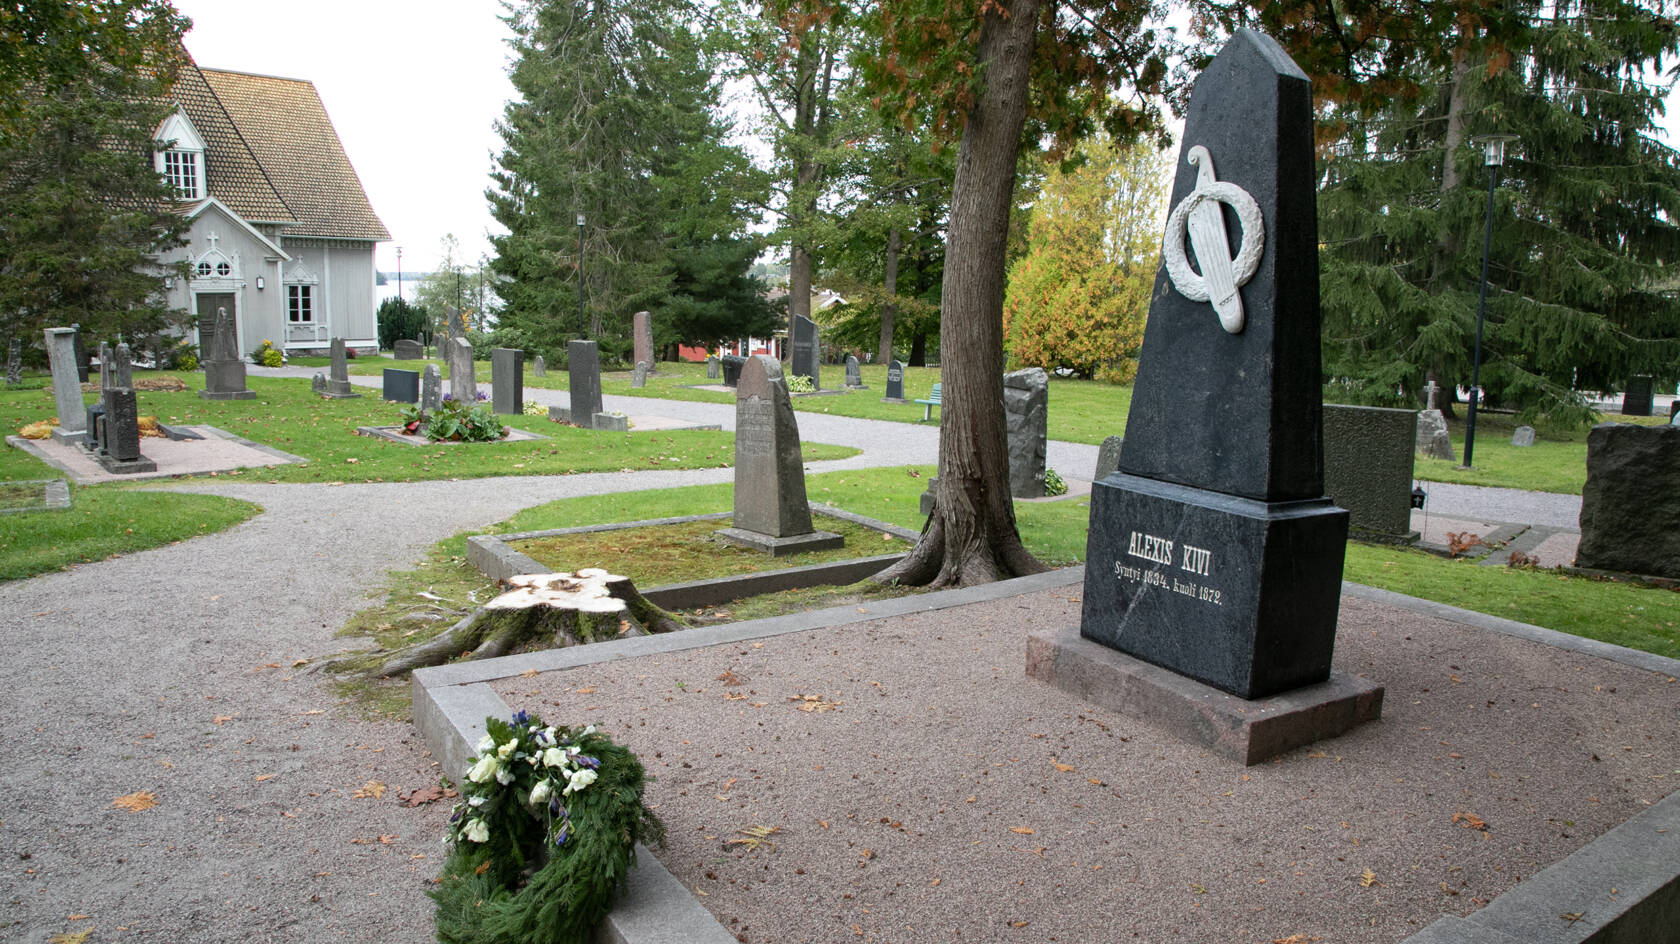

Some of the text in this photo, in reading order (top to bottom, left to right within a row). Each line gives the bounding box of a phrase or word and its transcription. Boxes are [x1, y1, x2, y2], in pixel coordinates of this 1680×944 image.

[1128, 531, 1211, 576] ALEXIS KIVI
[1115, 560, 1140, 583] Syntyi
[1173, 578, 1197, 597] kuoli
[1199, 587, 1222, 605] 1872.
